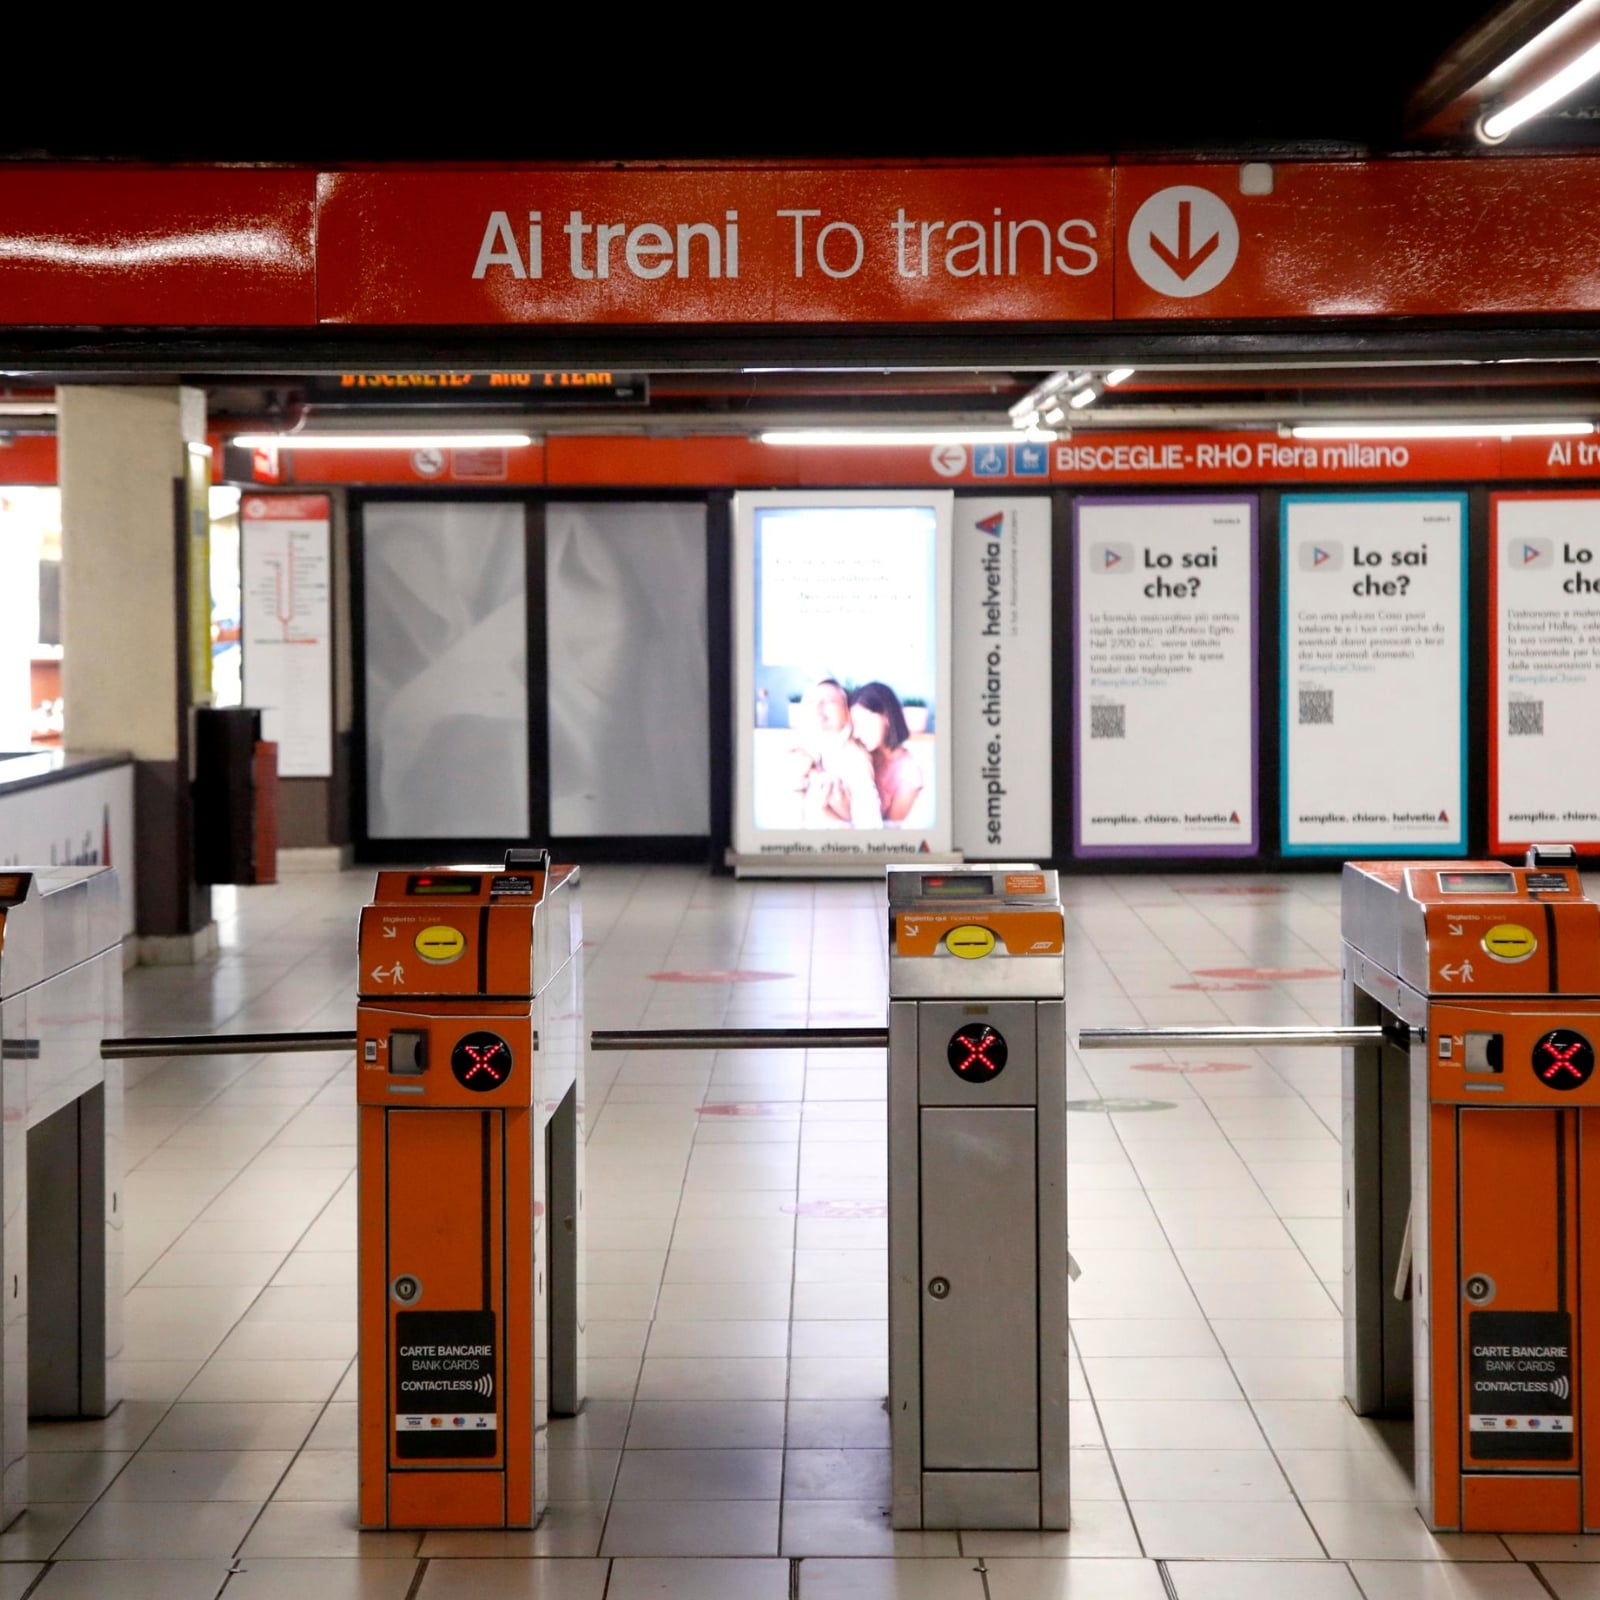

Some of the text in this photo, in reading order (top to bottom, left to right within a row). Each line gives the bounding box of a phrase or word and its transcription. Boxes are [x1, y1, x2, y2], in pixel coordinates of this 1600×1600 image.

[472, 208, 1098, 280] Ai treni To trains
[1257, 443, 1318, 468] Fiera
[1322, 443, 1410, 470] milano
[1547, 441, 1600, 466] Ai tr
[1144, 545, 1218, 568] Lo sai
[1353, 544, 1427, 567] Lo sai
[1563, 543, 1593, 564] Lo
[1143, 574, 1201, 598] che?
[1353, 573, 1411, 597] che?
[981, 542, 1007, 845] semplice. chiaro. helvetia
[400, 1345, 492, 1356] CARTE BANCARIE
[1473, 1346, 1568, 1357] CARTE BANCARIE
[412, 1359, 480, 1370] BANK CARDS
[1486, 1361, 1556, 1372] BANK CARDS
[401, 1380, 473, 1391] CONTACTLESS
[1475, 1381, 1548, 1392] CONTACTLESS
